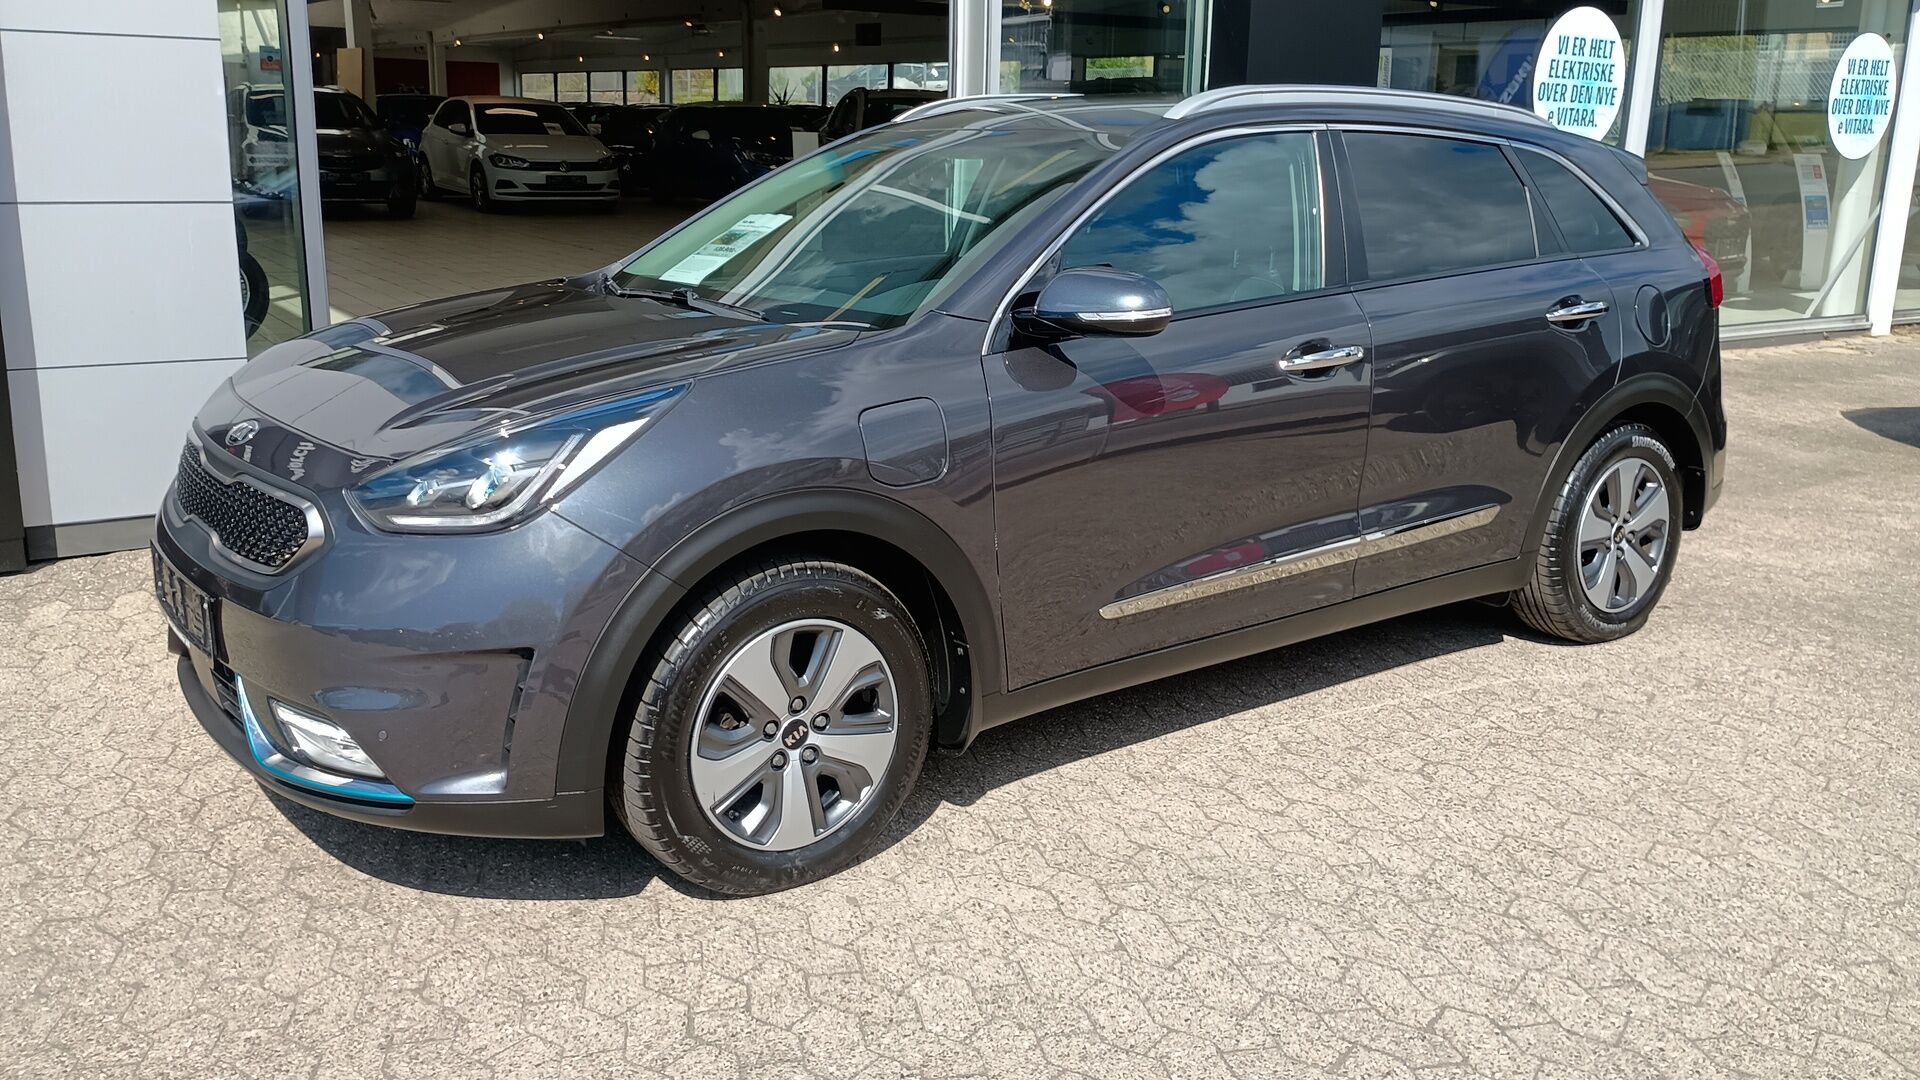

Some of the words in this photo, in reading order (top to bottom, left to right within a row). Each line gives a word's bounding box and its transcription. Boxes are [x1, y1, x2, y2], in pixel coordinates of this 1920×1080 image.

[1558, 34, 1569, 55] VI
[1572, 36, 1586, 57] ER
[1589, 37, 1616, 59] HELT
[1548, 58, 1615, 83] ELEKTRISKE
[1847, 58, 1857, 76] VI
[1857, 58, 1869, 76] ER
[1869, 59, 1890, 76] HELT
[1537, 81, 1568, 103] OVER
[1570, 84, 1594, 105] DEN
[1595, 86, 1618, 106] NYE
[1839, 78, 1889, 96] ELEKTRISKE
[1547, 110, 1554, 125] e
[1557, 106, 1598, 128] VITARA.
[1831, 97, 1854, 115] OVER
[1855, 98, 1872, 115] DEN
[1872, 99, 1890, 116] NYE
[1837, 121, 1843, 134] e
[1844, 118, 1875, 135] VITARA.
[1631, 435, 1676, 472] BRIDGESTONE
[784, 724, 808, 747] KIA
